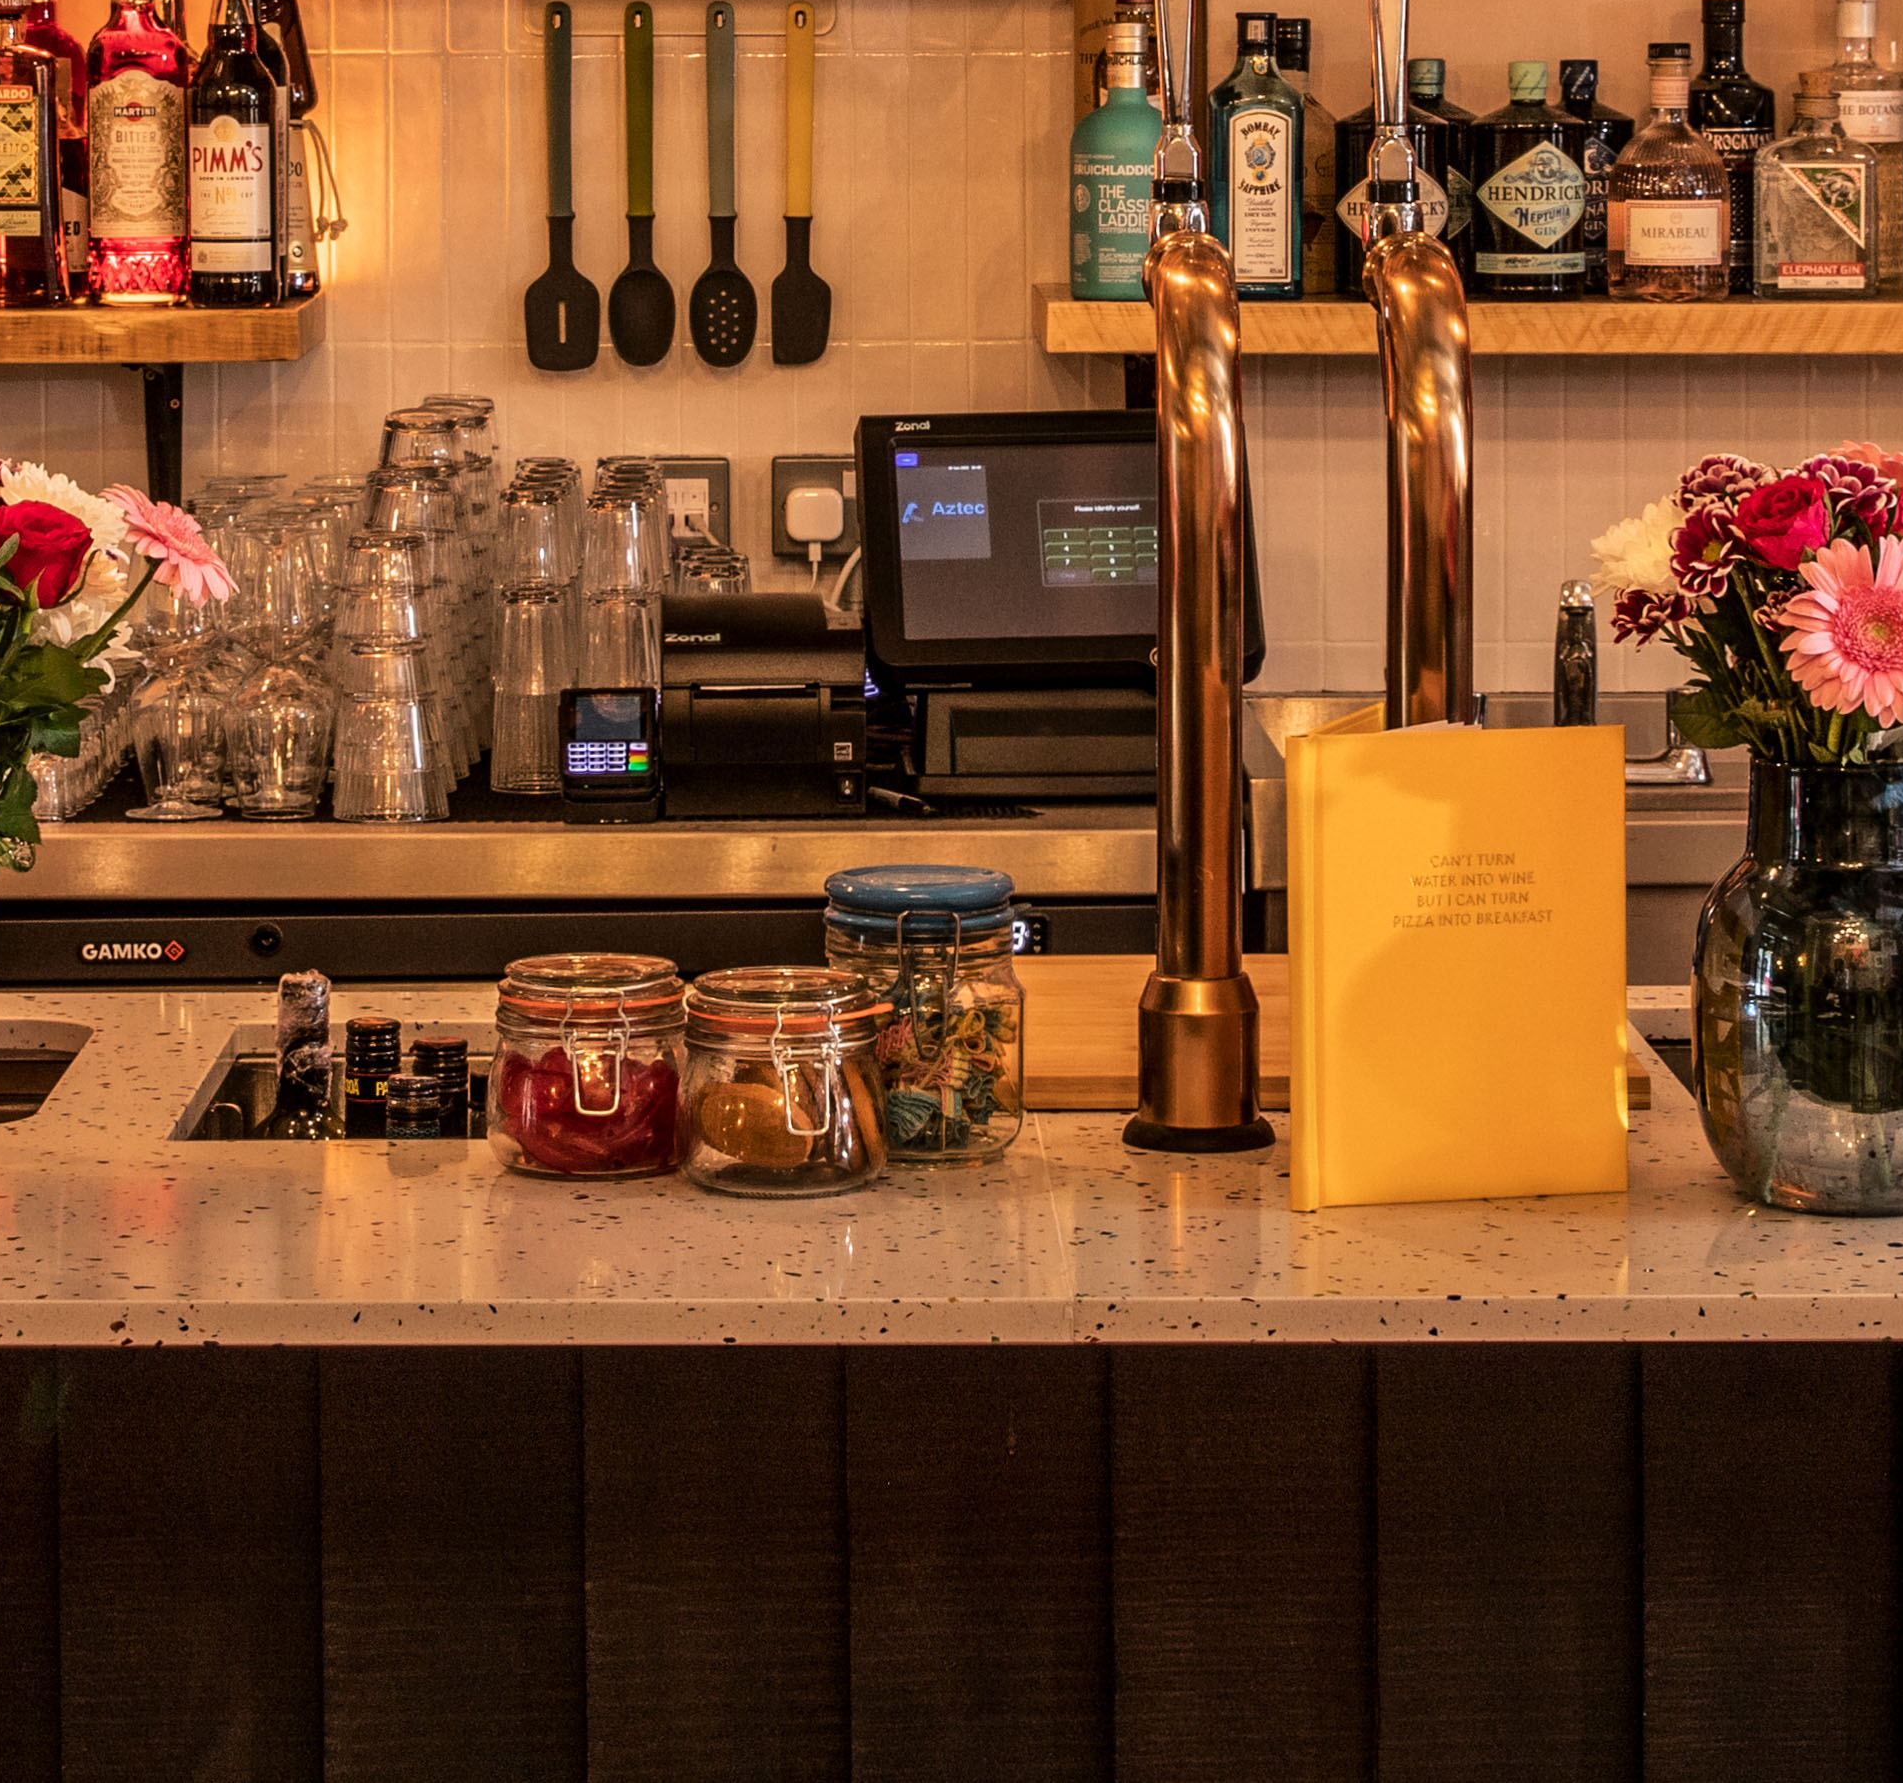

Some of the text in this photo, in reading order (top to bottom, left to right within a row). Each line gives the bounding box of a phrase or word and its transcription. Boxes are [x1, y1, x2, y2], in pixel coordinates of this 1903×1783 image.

[114, 107, 156, 117] MARTINI
[115, 130, 158, 143] BITTER
[1239, 121, 1282, 140] BOMBAY
[191, 140, 263, 174] PIMM'S
[1073, 164, 1156, 177] BRUICHLADDIC
[1098, 185, 1127, 199] THE
[1237, 178, 1283, 196] SAPPHIRE
[1098, 200, 1151, 213] CLASSI
[1098, 214, 1149, 228] LADDIE
[1514, 205, 1571, 228] NEPTUNIA
[1534, 226, 1559, 237] GIN
[1640, 226, 1711, 240] MIRABEAU
[1781, 263, 1861, 275] ELEPHANT GIN
[894, 420, 931, 433] Zonal
[931, 500, 987, 517] Aztec
[664, 631, 722, 644] Zonal
[1429, 853, 1516, 869] CAN'T TURN
[1410, 871, 1536, 889] WATER INTO WINE
[1416, 893, 1443, 909] BUT
[1456, 893, 1488, 907] CAN
[1490, 891, 1530, 906] TURN
[1392, 908, 1554, 929] PIZZA INTO BREAKFAST
[81, 942, 163, 962] GAMKO
